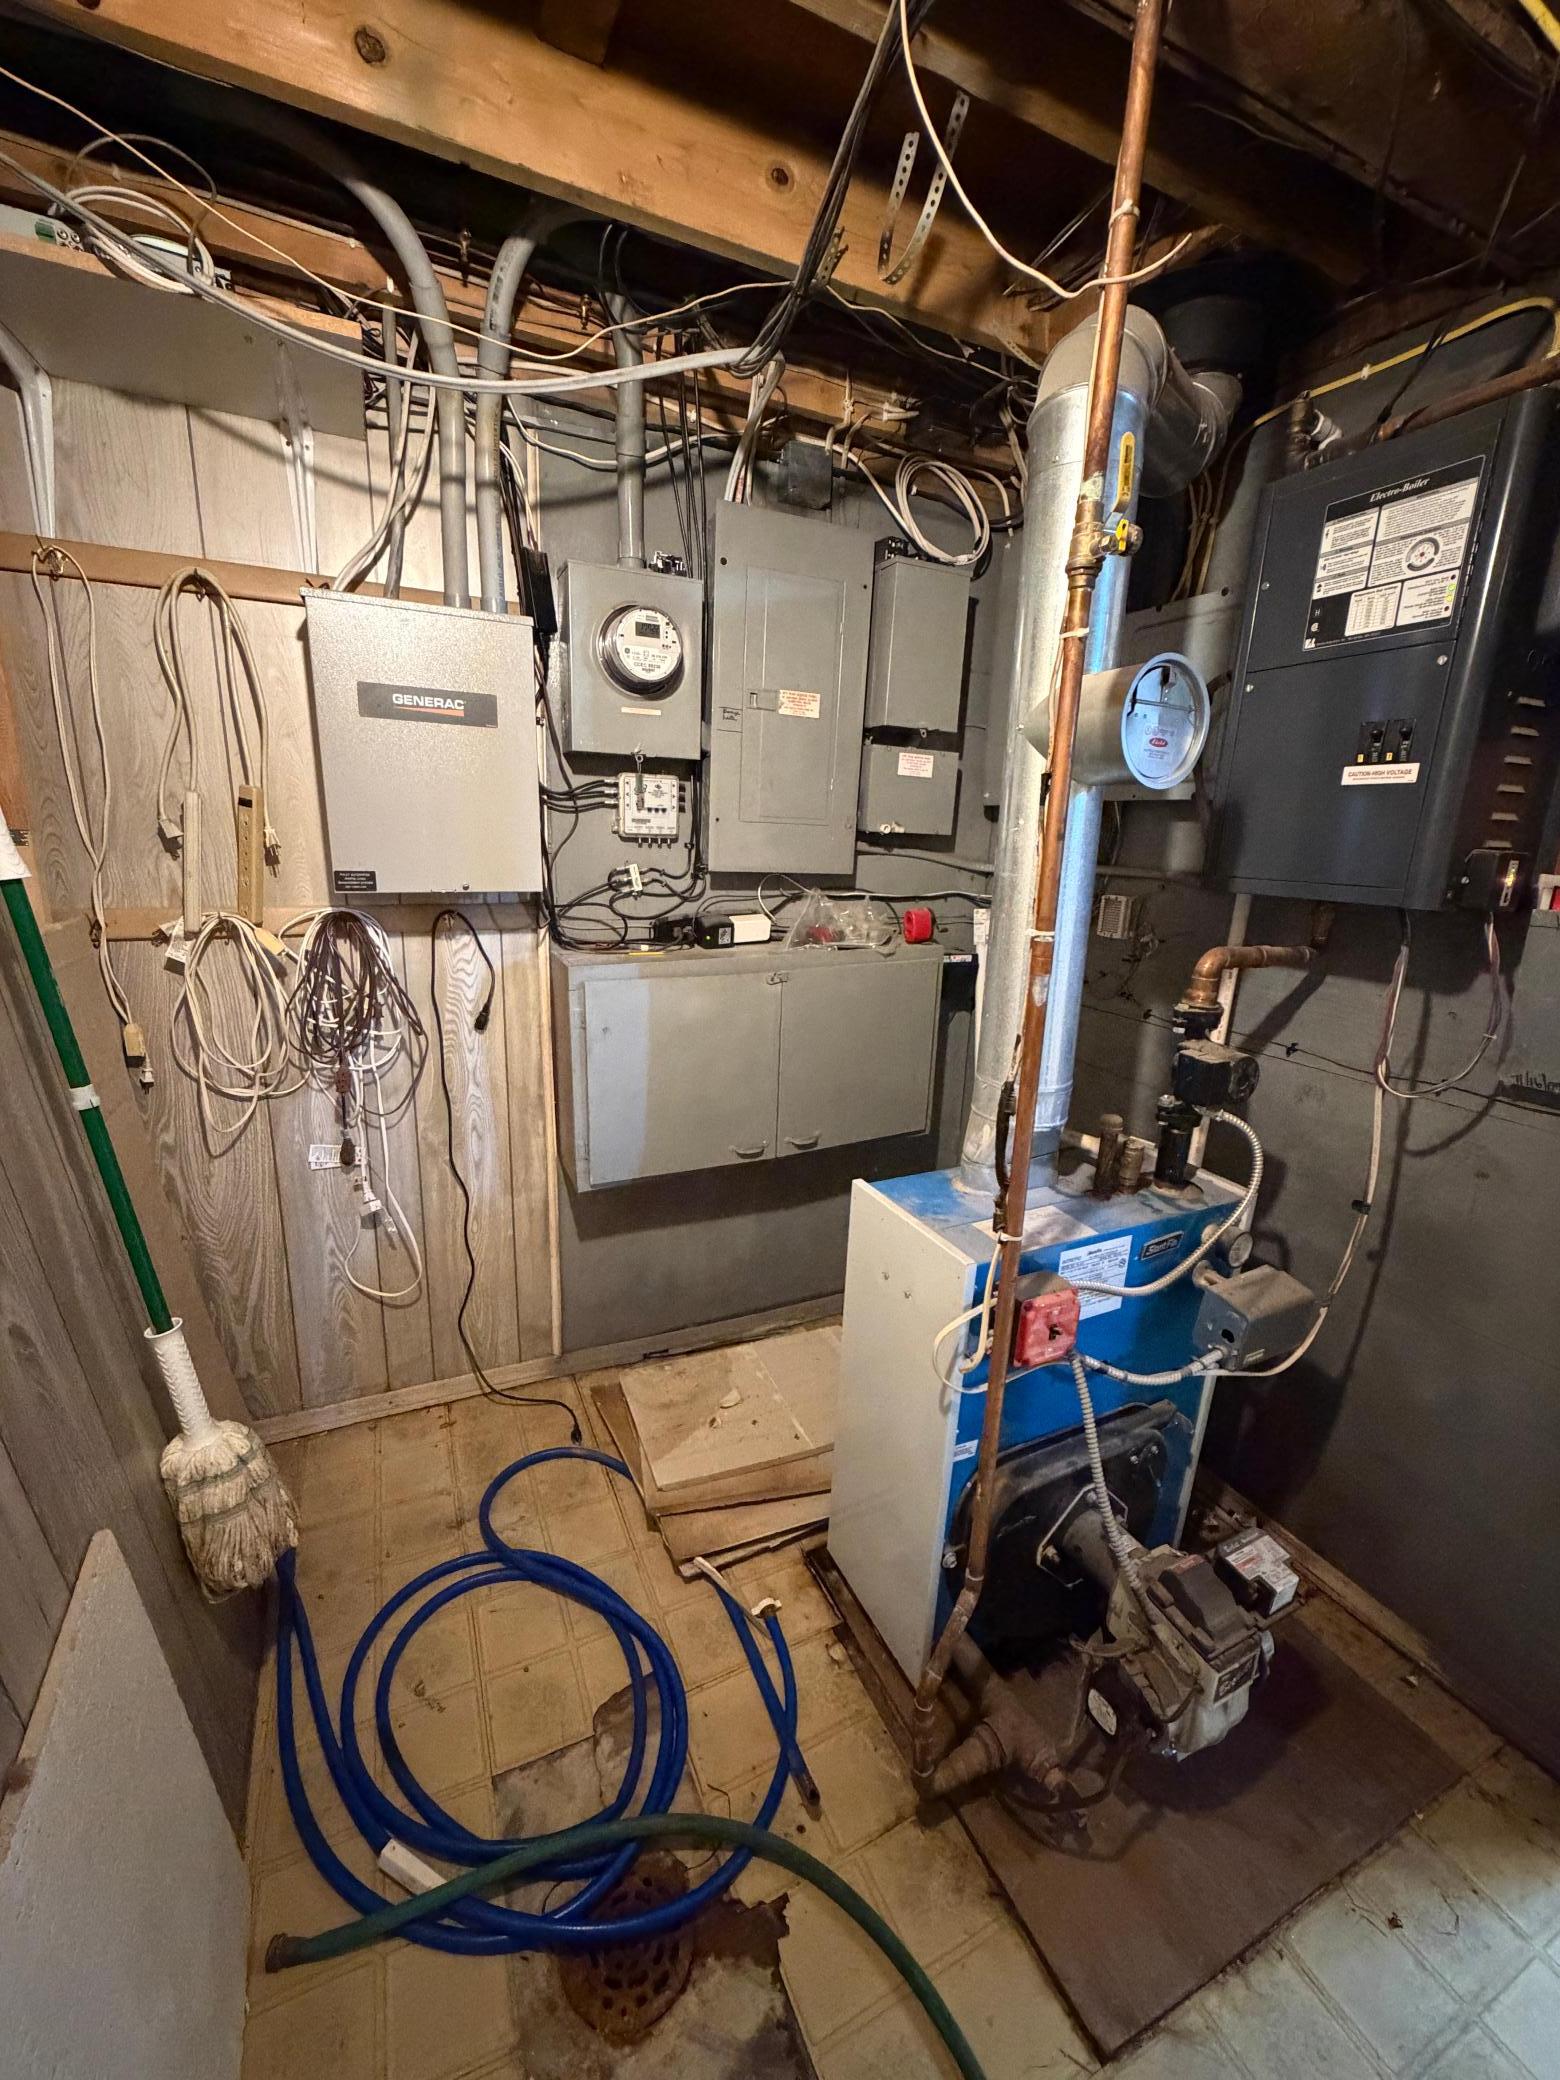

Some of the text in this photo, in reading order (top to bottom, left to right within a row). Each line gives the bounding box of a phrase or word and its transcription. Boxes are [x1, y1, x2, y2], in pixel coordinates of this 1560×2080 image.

[1369, 478, 1430, 502] Electro-Boiler
[392, 693, 465, 710] GENERAC
[1386, 768, 1412, 776] VOLTAGE
